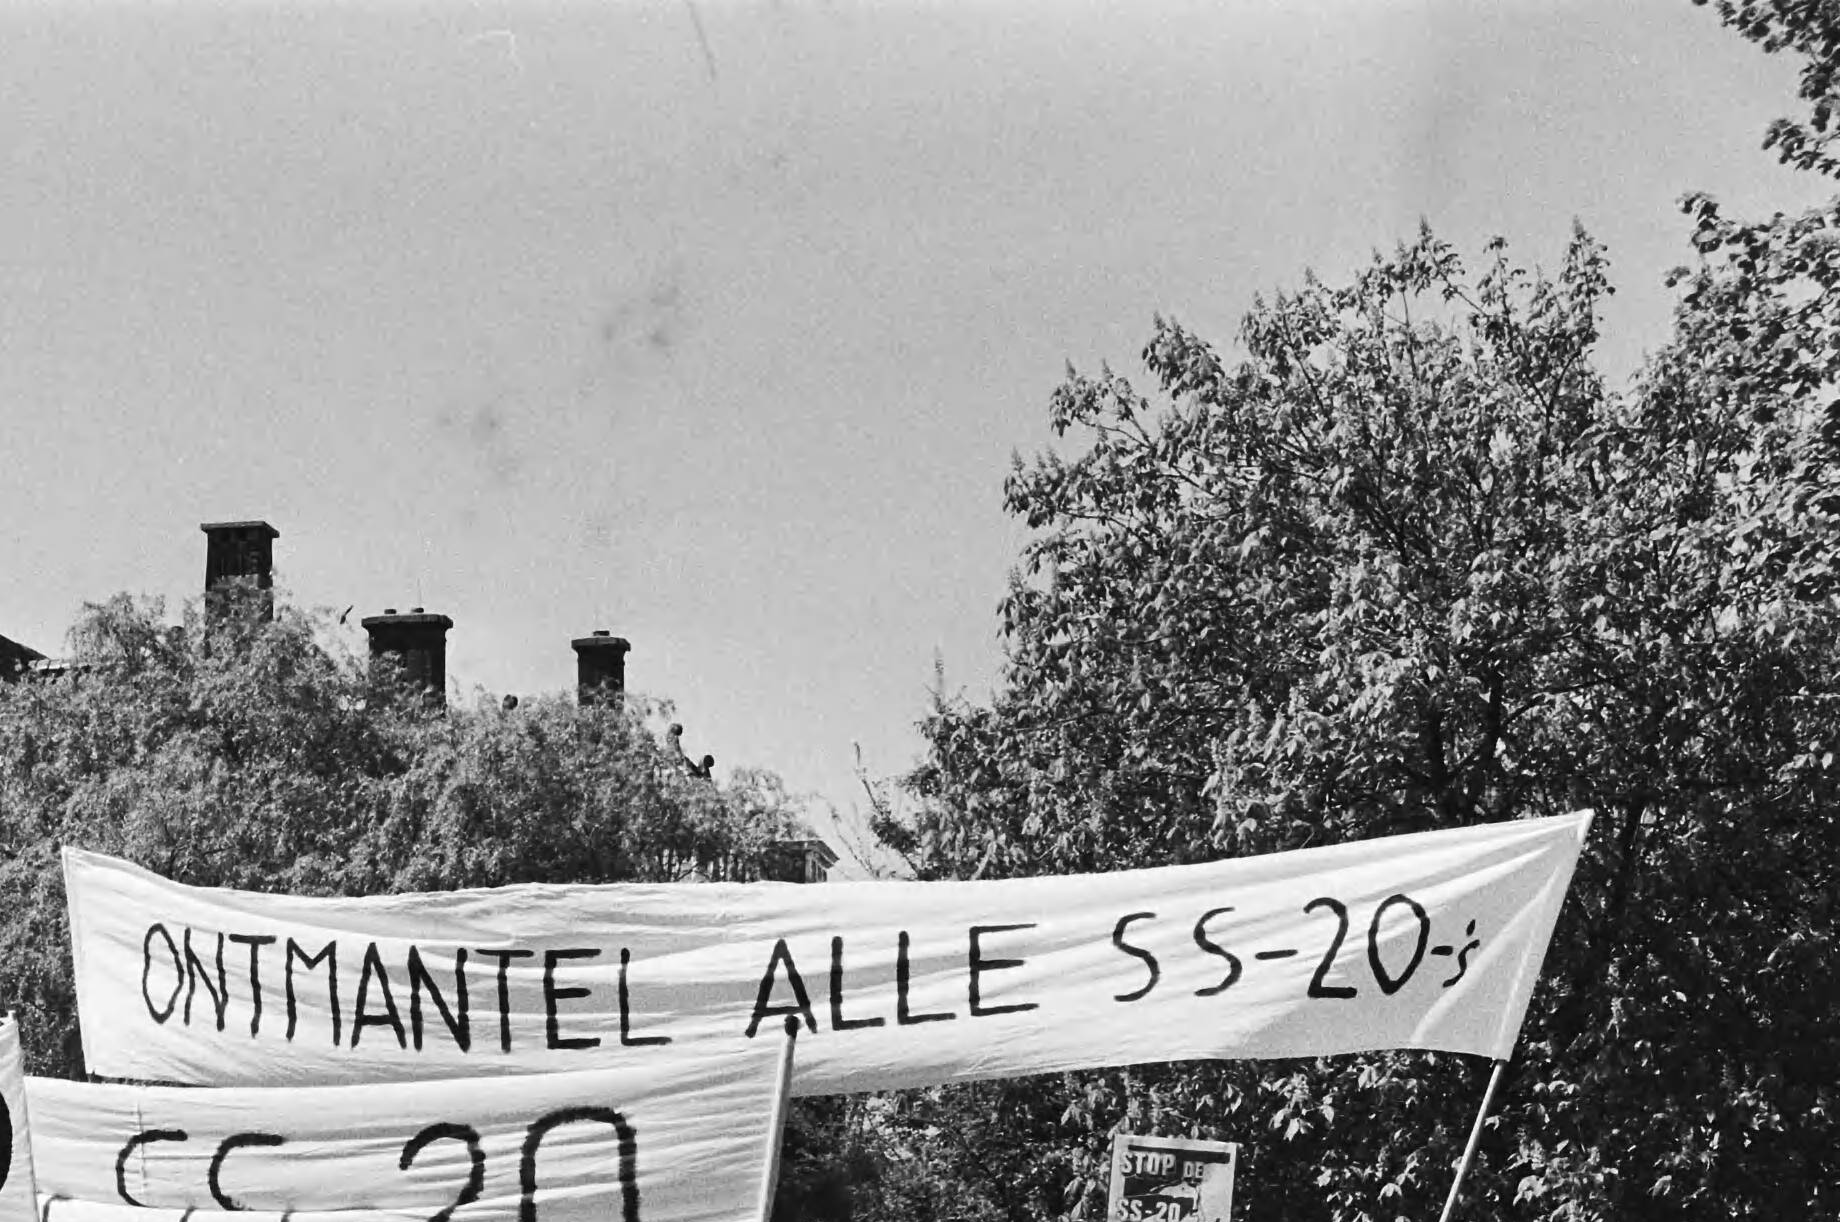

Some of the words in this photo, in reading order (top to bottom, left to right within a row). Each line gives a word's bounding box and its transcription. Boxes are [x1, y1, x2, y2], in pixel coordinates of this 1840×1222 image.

[143, 922, 673, 1053] ONTMANTEL
[745, 922, 1040, 1037] ALLE
[1120, 1151, 1176, 1176] STOP
[1183, 1161, 1204, 1178] DE
